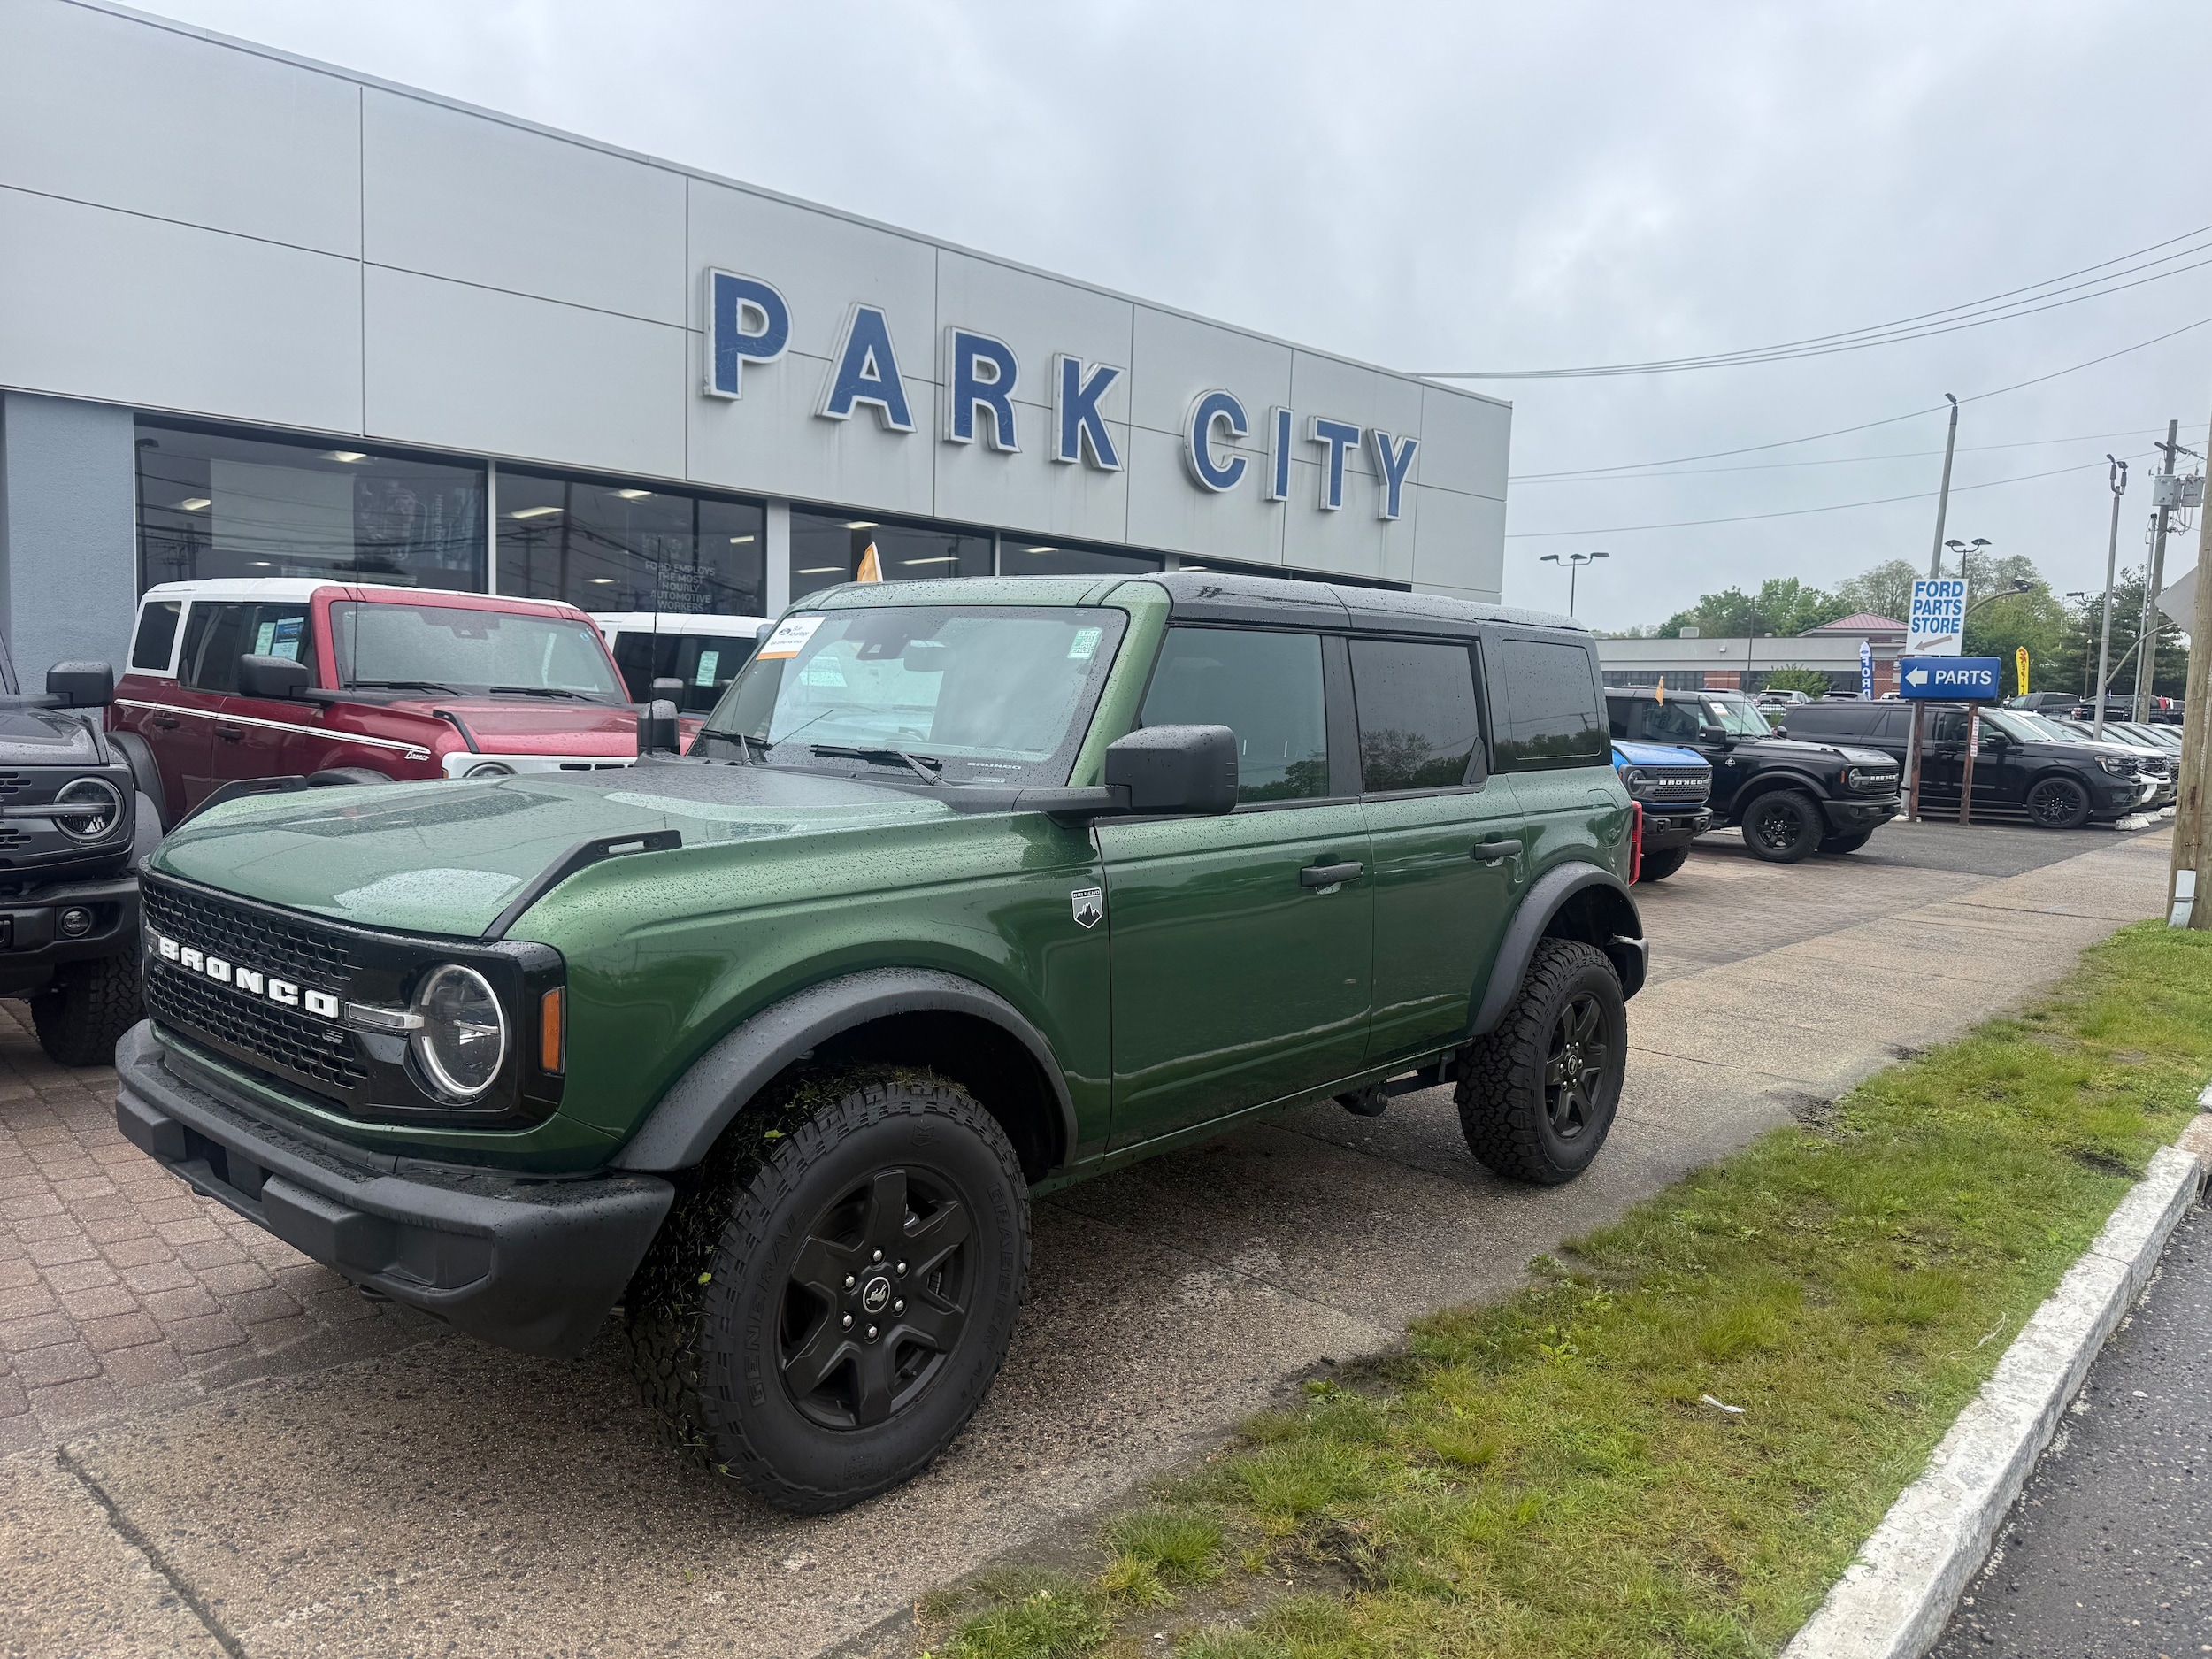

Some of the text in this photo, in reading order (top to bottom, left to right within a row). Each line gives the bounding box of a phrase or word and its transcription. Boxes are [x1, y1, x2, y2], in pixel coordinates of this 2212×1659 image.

[703, 266, 1421, 520] PARK CITY
[645, 560, 716, 576] FORD EMPLOYS
[657, 572, 704, 584] THE MOST
[662, 581, 700, 593] HOURLY
[1915, 581, 1963, 597] FORD
[650, 590, 711, 603] AUTOMOTIVE
[657, 600, 703, 611] WORKERS
[1913, 599, 1962, 616] PARTS
[1911, 617, 1960, 634] STORE
[1935, 670, 1992, 685] PARTS
[159, 936, 339, 1018] BRONCO
[745, 1209, 806, 1408] GENERAL
